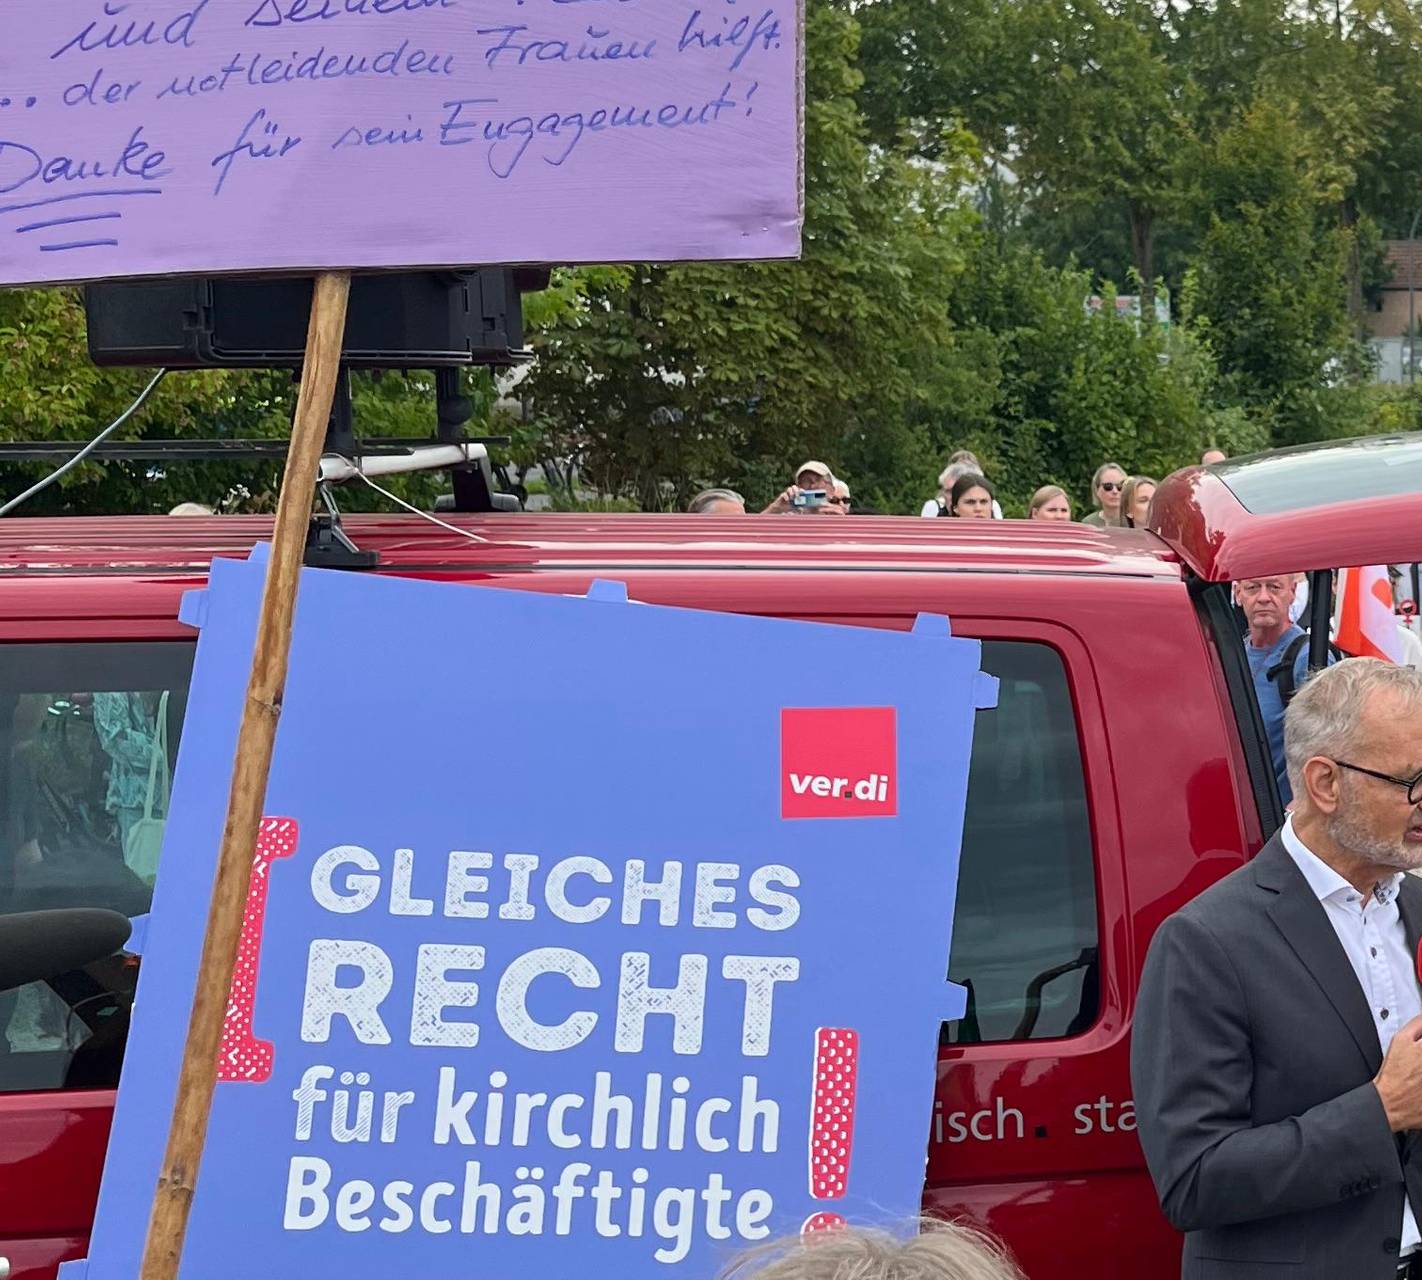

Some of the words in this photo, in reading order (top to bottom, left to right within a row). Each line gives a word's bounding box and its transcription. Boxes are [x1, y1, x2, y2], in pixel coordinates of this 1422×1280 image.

[63, 69, 142, 106] der
[157, 40, 453, 99] notleidenden
[477, 25, 656, 68] Frauen
[679, 10, 781, 71] hilft.
[0, 126, 172, 193] Danke
[212, 108, 301, 196] für
[332, 115, 423, 149] sein
[789, 773, 889, 802] ver.di
[310, 845, 802, 930] GLEICHES
[301, 938, 800, 1056] RECHT
[292, 1065, 414, 1143] für
[433, 1067, 780, 1154] kirchlich
[283, 1156, 773, 1264] Beschäftigte
